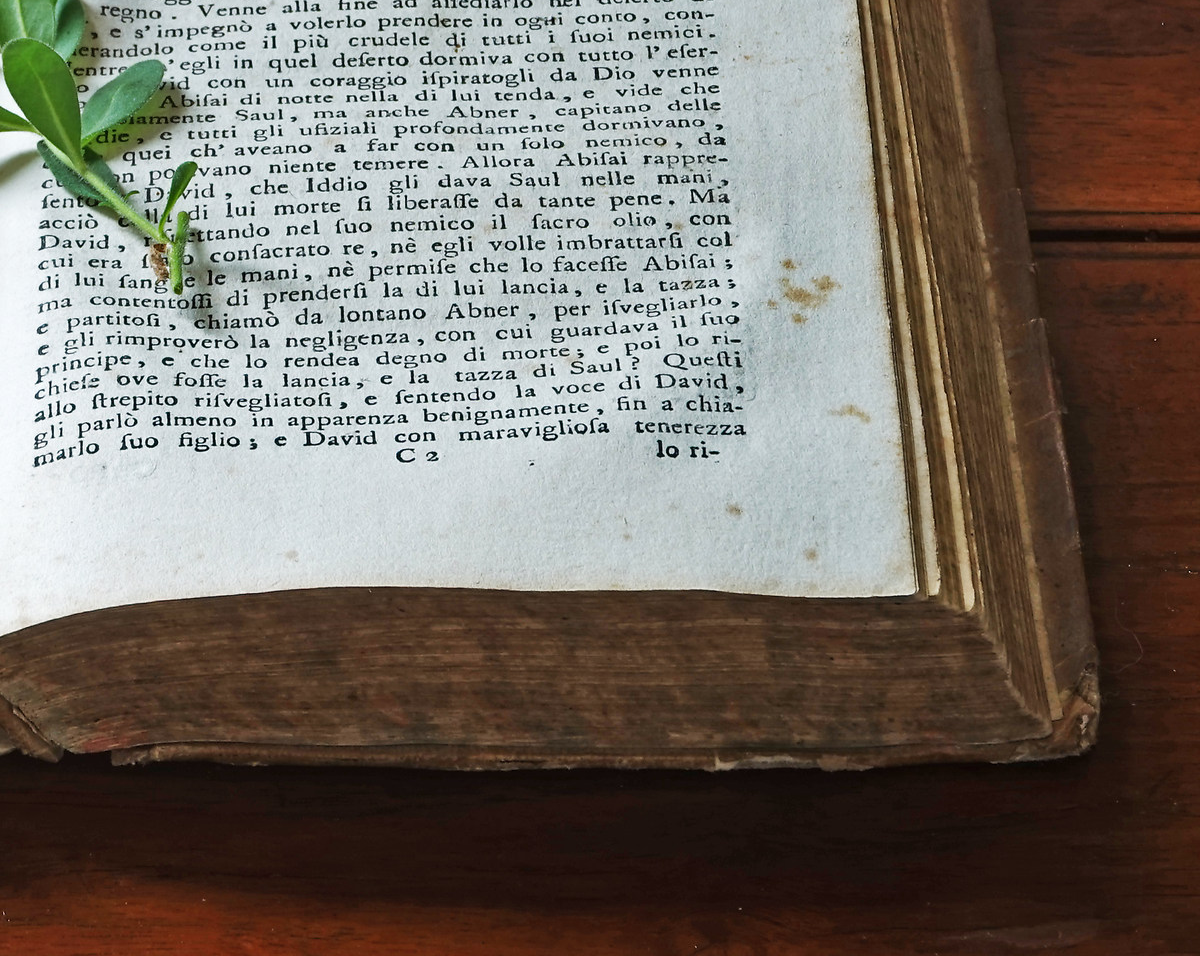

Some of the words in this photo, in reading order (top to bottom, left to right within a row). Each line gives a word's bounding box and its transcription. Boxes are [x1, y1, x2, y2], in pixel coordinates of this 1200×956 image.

[198, 4, 267, 17] Venne
[290, 15, 366, 30] volerlo
[378, 13, 472, 31] prendere
[189, 41, 245, 52] come
[294, 34, 328, 53] più
[269, 53, 317, 73] quel
[420, 51, 512, 66] dormiva
[579, 51, 633, 62] tutto
[593, 66, 635, 80] Dio
[652, 66, 719, 78] venne
[278, 95, 333, 104] notte
[555, 103, 651, 119] capitano
[668, 98, 721, 111] delle
[299, 121, 376, 136] ufiziali
[393, 121, 564, 138] profondamente
[123, 145, 171, 166] quei
[235, 145, 312, 156] aveano
[269, 160, 336, 173] niente
[461, 156, 535, 168] Allora
[643, 155, 728, 169] rappre-
[306, 176, 367, 192] Iddio
[438, 174, 491, 188] dava
[581, 171, 635, 186] nelle
[274, 202, 340, 215] morte
[539, 196, 595, 207] tante
[39, 213, 98, 229] acciò
[391, 220, 474, 232] nemico
[488, 235, 545, 251] volle
[194, 311, 279, 329] chiamò
[339, 306, 426, 323] lontano
[106, 335, 238, 353] rimproverò
[551, 321, 659, 343] guardava
[284, 353, 359, 368] rendea
[376, 351, 447, 369] degno
[455, 370, 517, 382] tazza
[34, 401, 76, 424] allo
[552, 383, 605, 395] voce
[78, 412, 138, 438] parlò
[152, 412, 236, 427] almeno
[288, 414, 408, 433] apparenza
[32, 440, 99, 467] marlo
[303, 430, 377, 446] David
[635, 421, 746, 435] tenerezza
[396, 448, 415, 463] C
[426, 451, 439, 461] 2
[656, 440, 679, 458] lo
[690, 446, 720, 458] ri-
